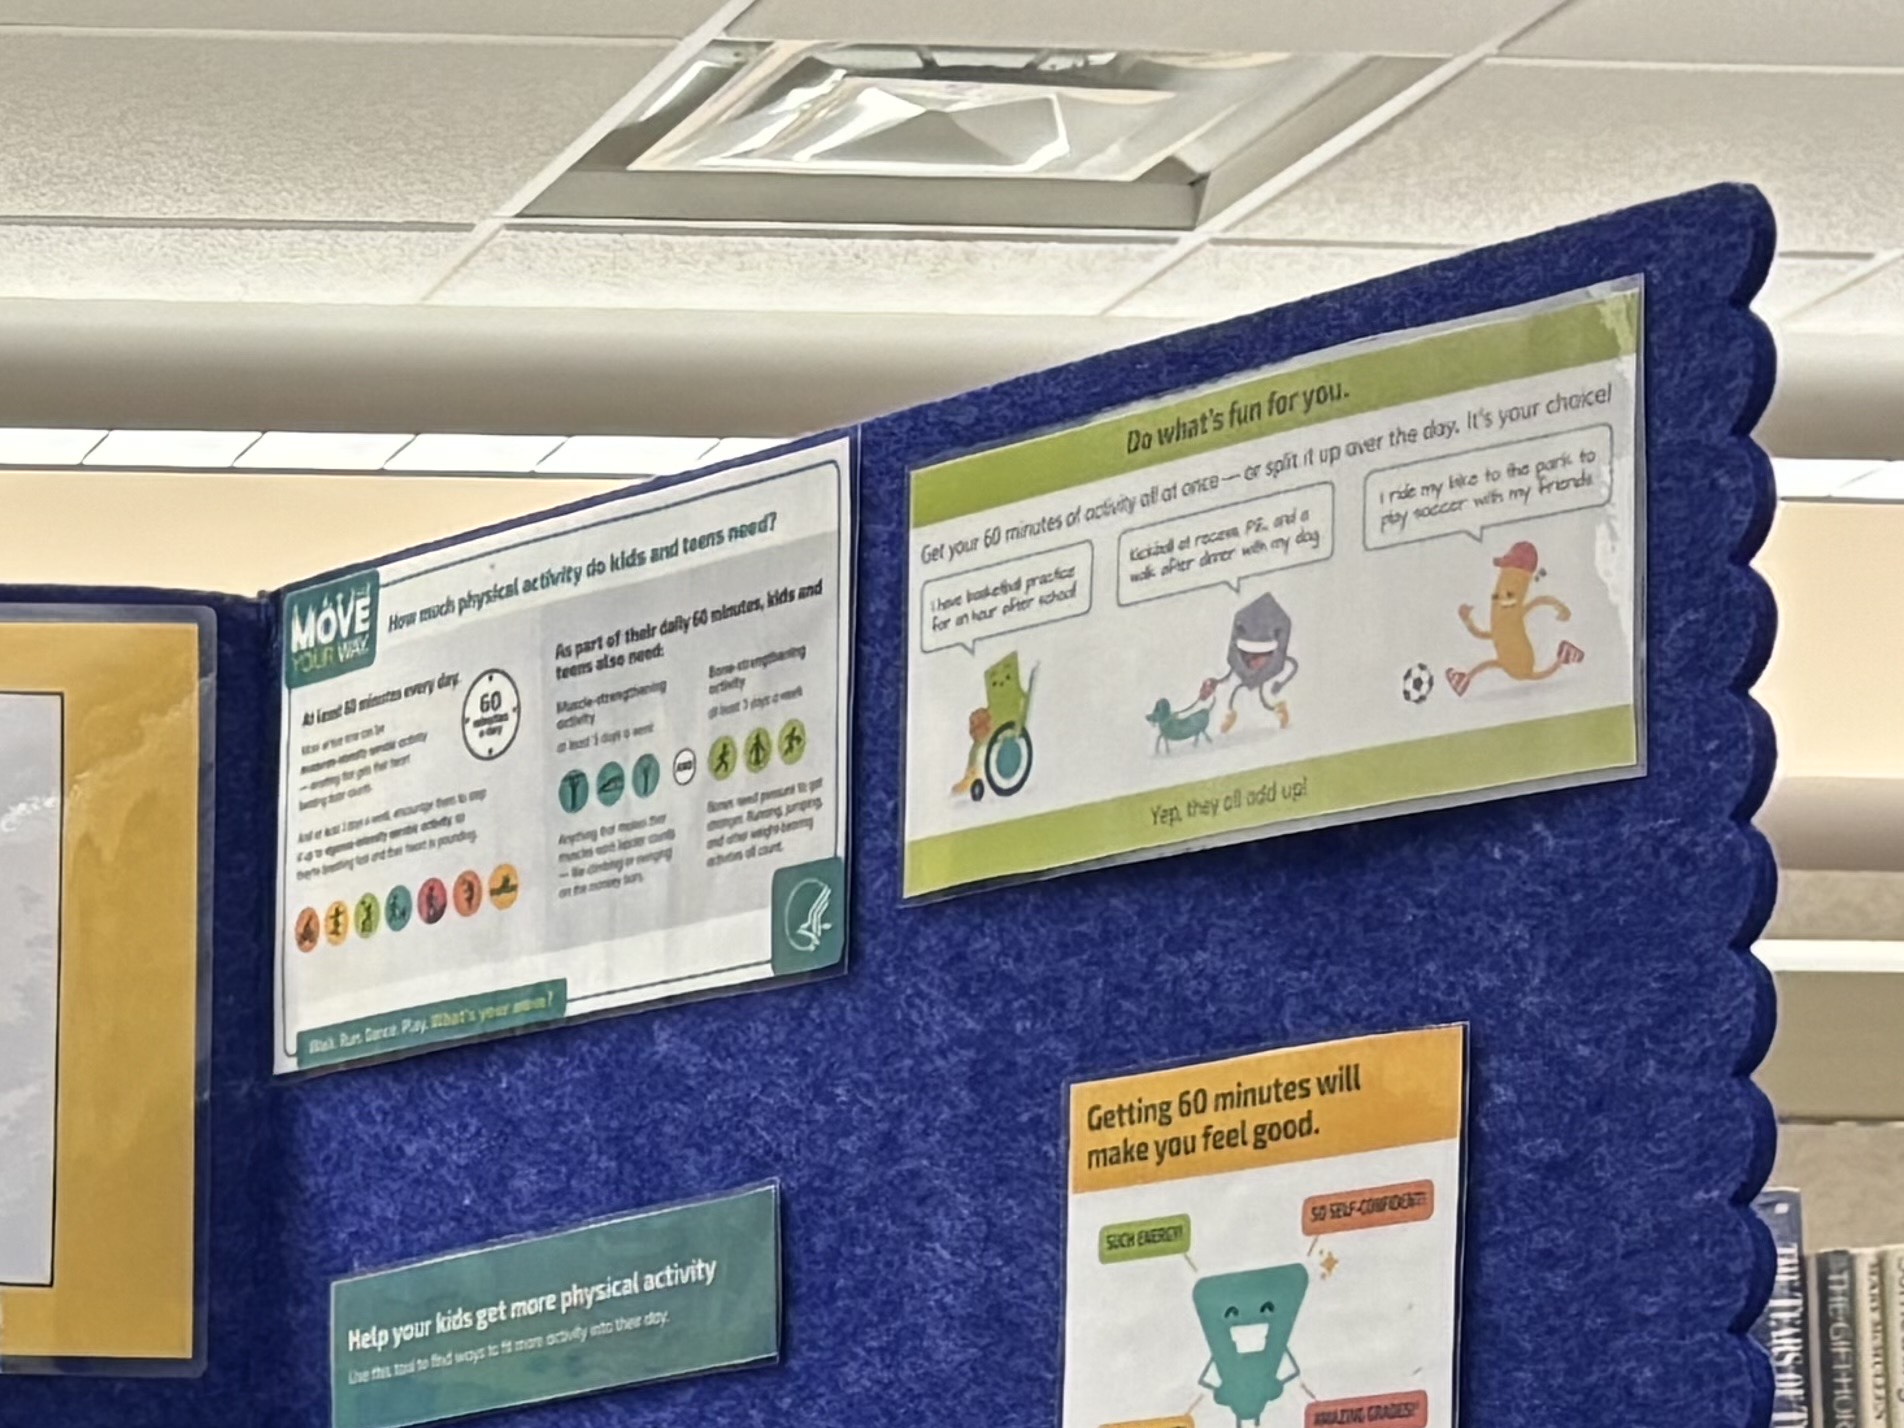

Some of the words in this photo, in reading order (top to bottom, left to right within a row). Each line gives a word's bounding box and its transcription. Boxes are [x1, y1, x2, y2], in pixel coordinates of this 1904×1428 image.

[1127, 429, 1153, 454] Do
[1157, 408, 1224, 446] what's
[1229, 401, 1262, 428] fun
[1267, 391, 1299, 417] for
[1302, 382, 1350, 415] you.
[291, 594, 370, 648] MOVE
[292, 644, 334, 674] YOUR
[1087, 1097, 1173, 1132] Getting
[1178, 1088, 1208, 1118] 60
[1214, 1077, 1311, 1113] minutes
[1316, 1063, 1361, 1096] will
[1087, 1137, 1149, 1170] make
[1154, 1134, 1197, 1166] you
[1201, 1119, 1248, 1152] feel
[1252, 1109, 1320, 1150] good.
[348, 1325, 389, 1352] Help
[392, 1320, 432, 1348] your
[436, 1307, 473, 1334] kids
[475, 1300, 507, 1331] get
[510, 1293, 557, 1319] more
[560, 1271, 640, 1314] physical
[643, 1258, 717, 1292] activity
